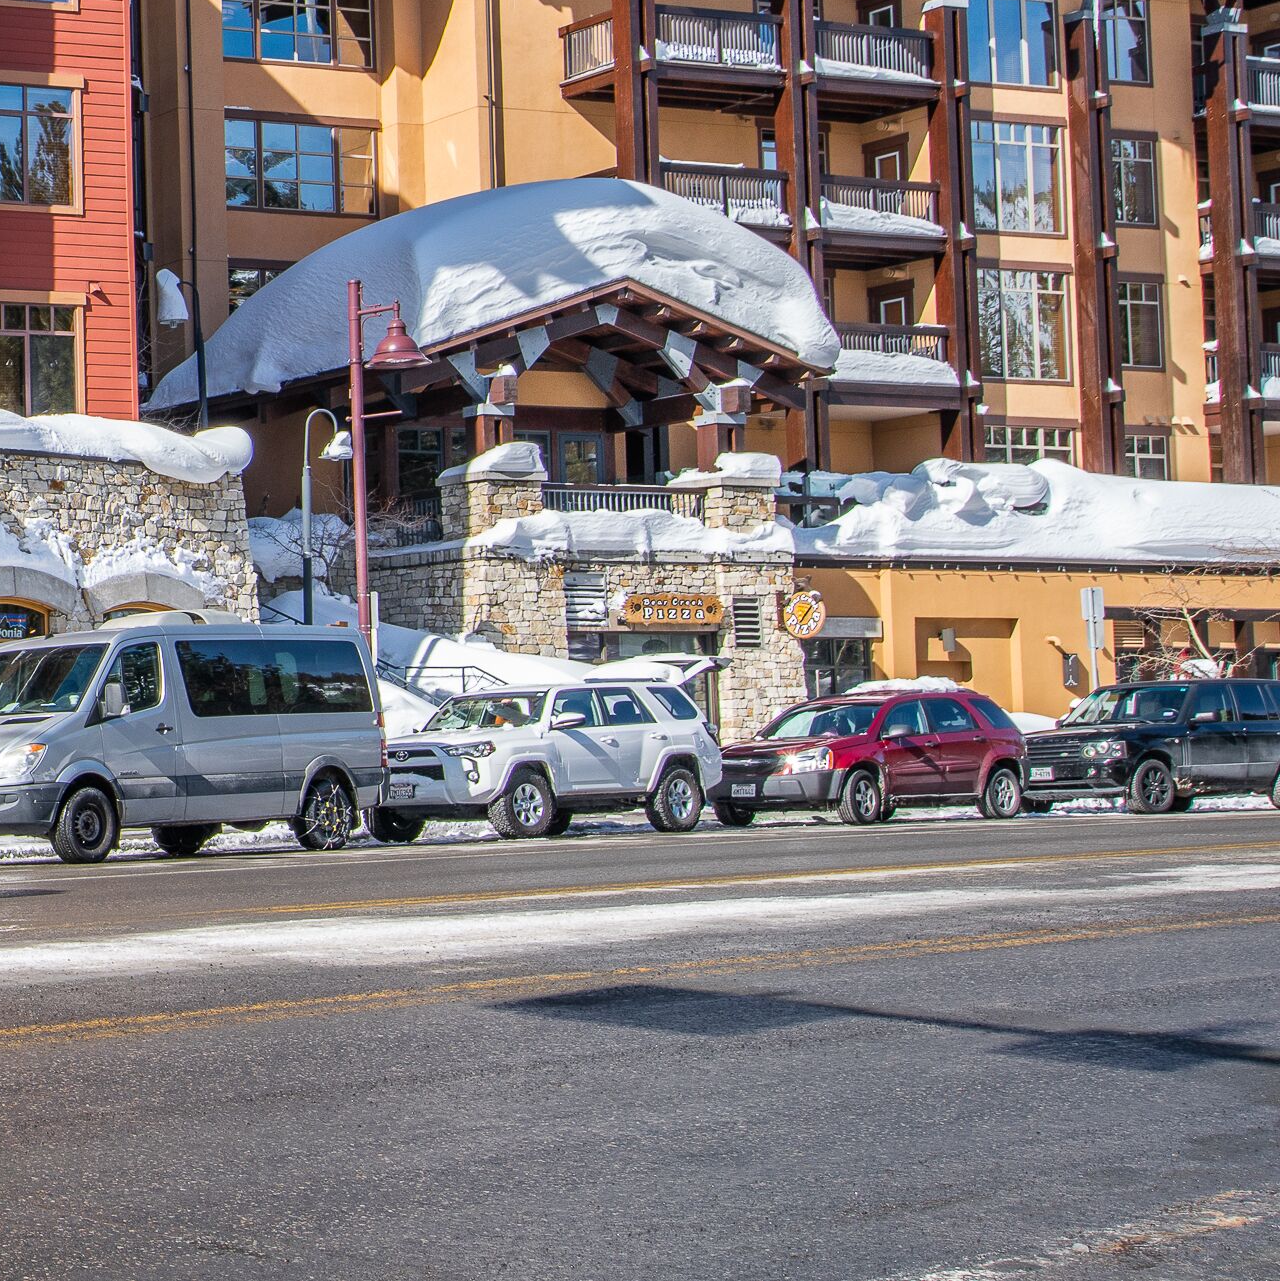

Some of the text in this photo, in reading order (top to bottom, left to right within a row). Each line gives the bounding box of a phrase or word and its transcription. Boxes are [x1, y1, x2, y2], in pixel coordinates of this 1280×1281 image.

[642, 596, 703, 606] Bear Creek
[643, 607, 705, 619] Pizza
